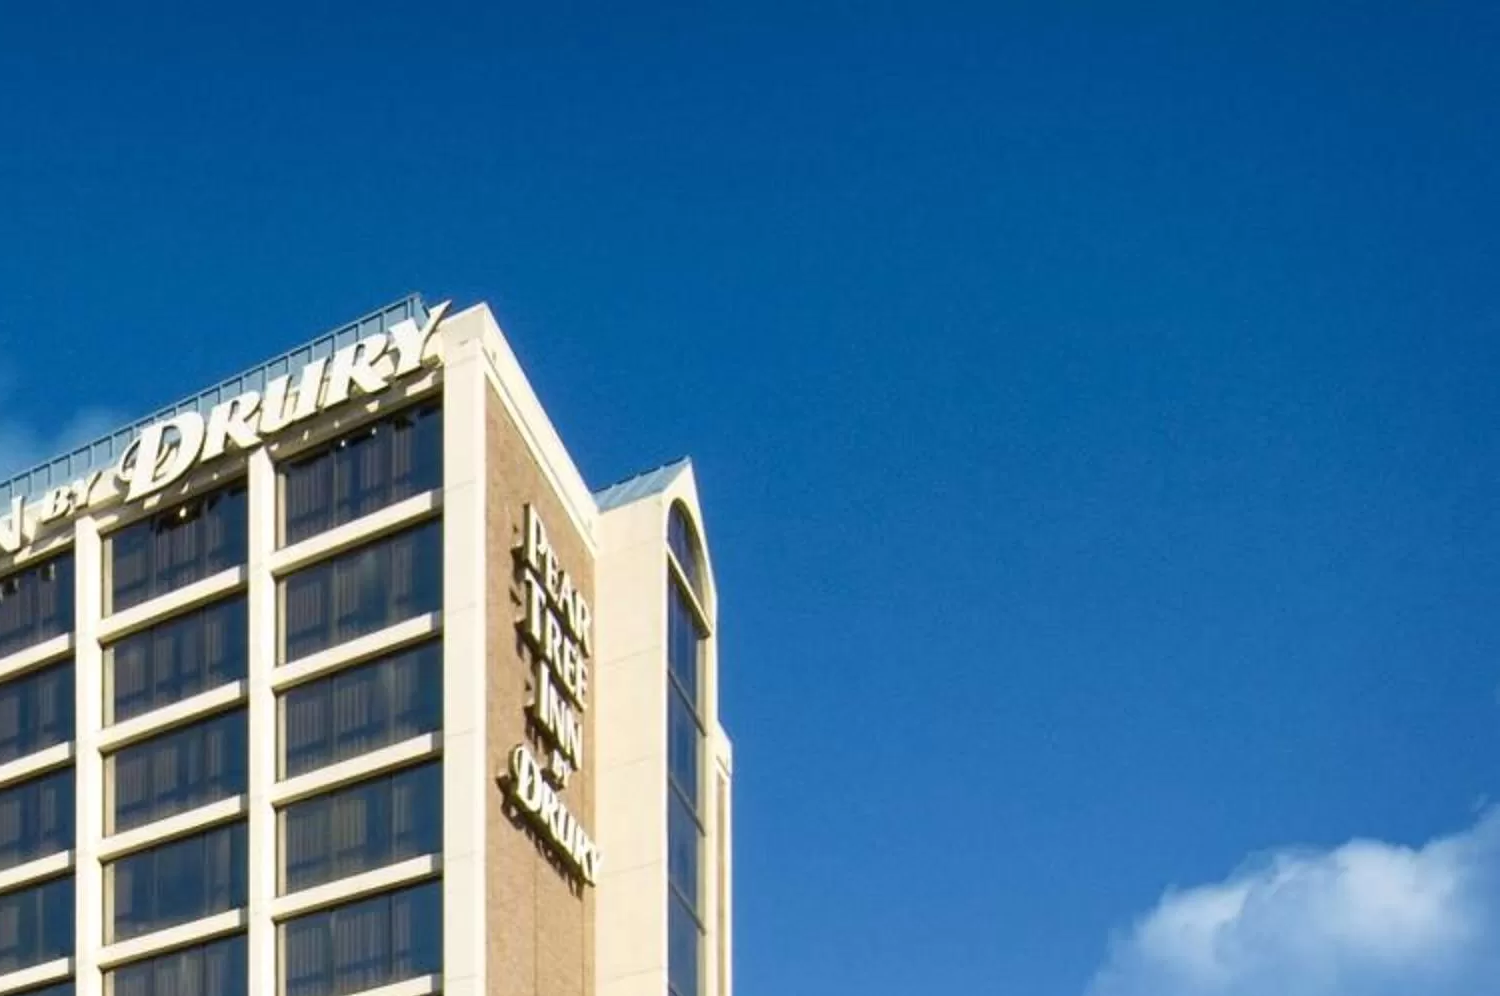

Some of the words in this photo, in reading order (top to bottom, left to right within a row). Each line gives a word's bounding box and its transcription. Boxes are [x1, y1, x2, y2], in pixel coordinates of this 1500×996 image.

[40, 470, 103, 525] BY
[118, 299, 452, 503] DRURY
[523, 501, 592, 657] PEAR
[524, 567, 589, 712] TREE
[536, 659, 583, 772] INN
[508, 743, 603, 887] DRURY
